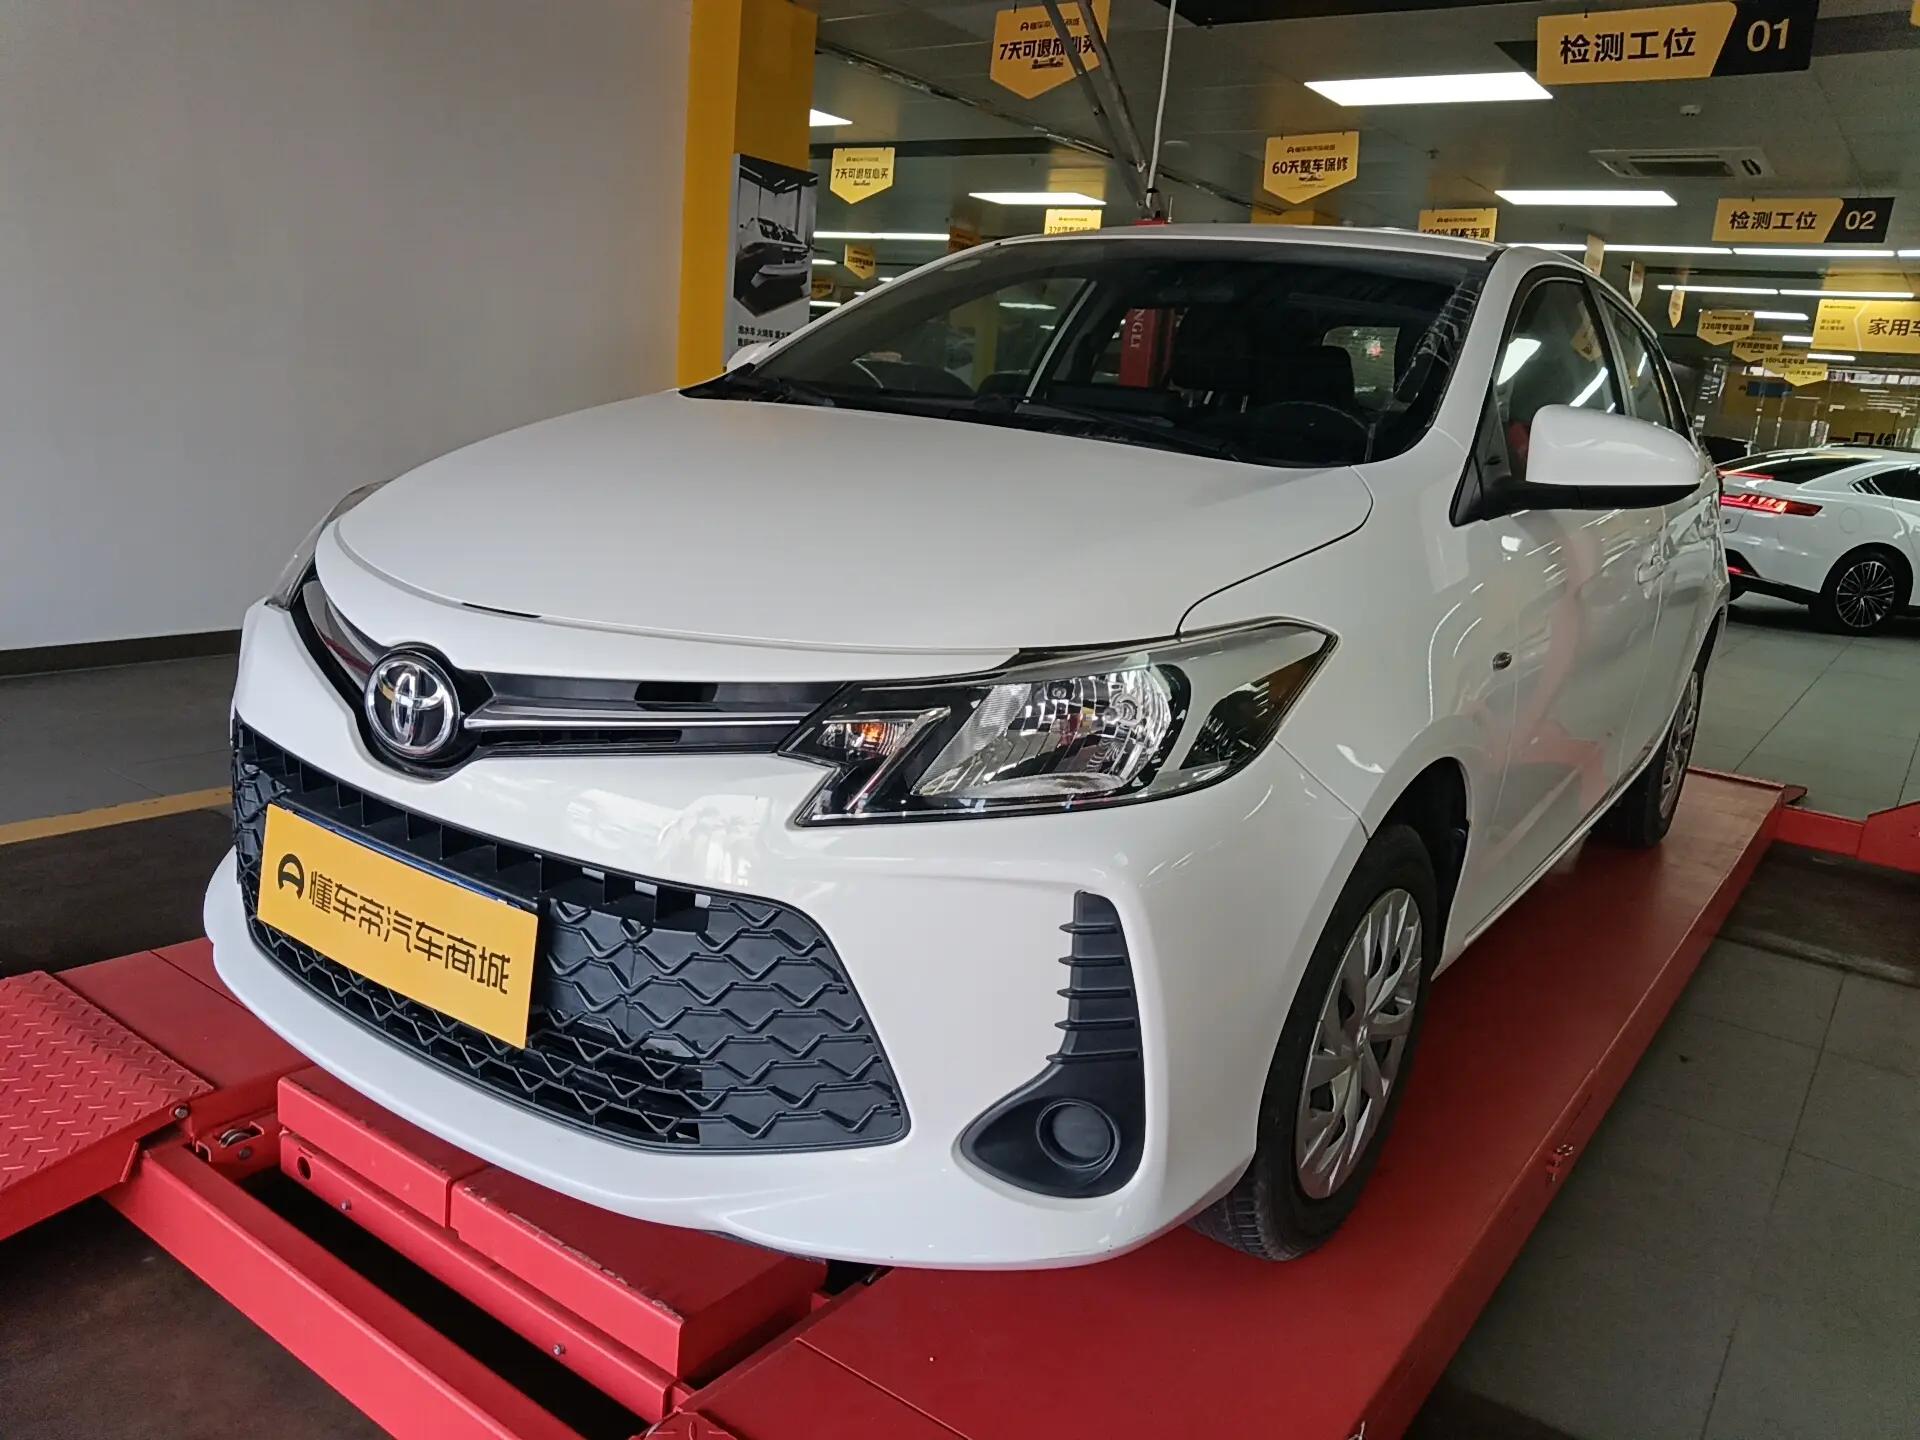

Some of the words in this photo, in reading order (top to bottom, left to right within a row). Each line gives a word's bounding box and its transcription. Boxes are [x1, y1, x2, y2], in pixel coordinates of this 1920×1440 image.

[1560, 27, 1697, 64] 检测工位
[1746, 18, 1791, 52] 01
[835, 167, 889, 180] 7天可退放心买
[1272, 157, 1349, 175] 60天整车保修
[1729, 210, 1817, 230] 检测工位
[1844, 210, 1877, 230] 02
[309, 870, 511, 995] 懂车帝汽车商城
